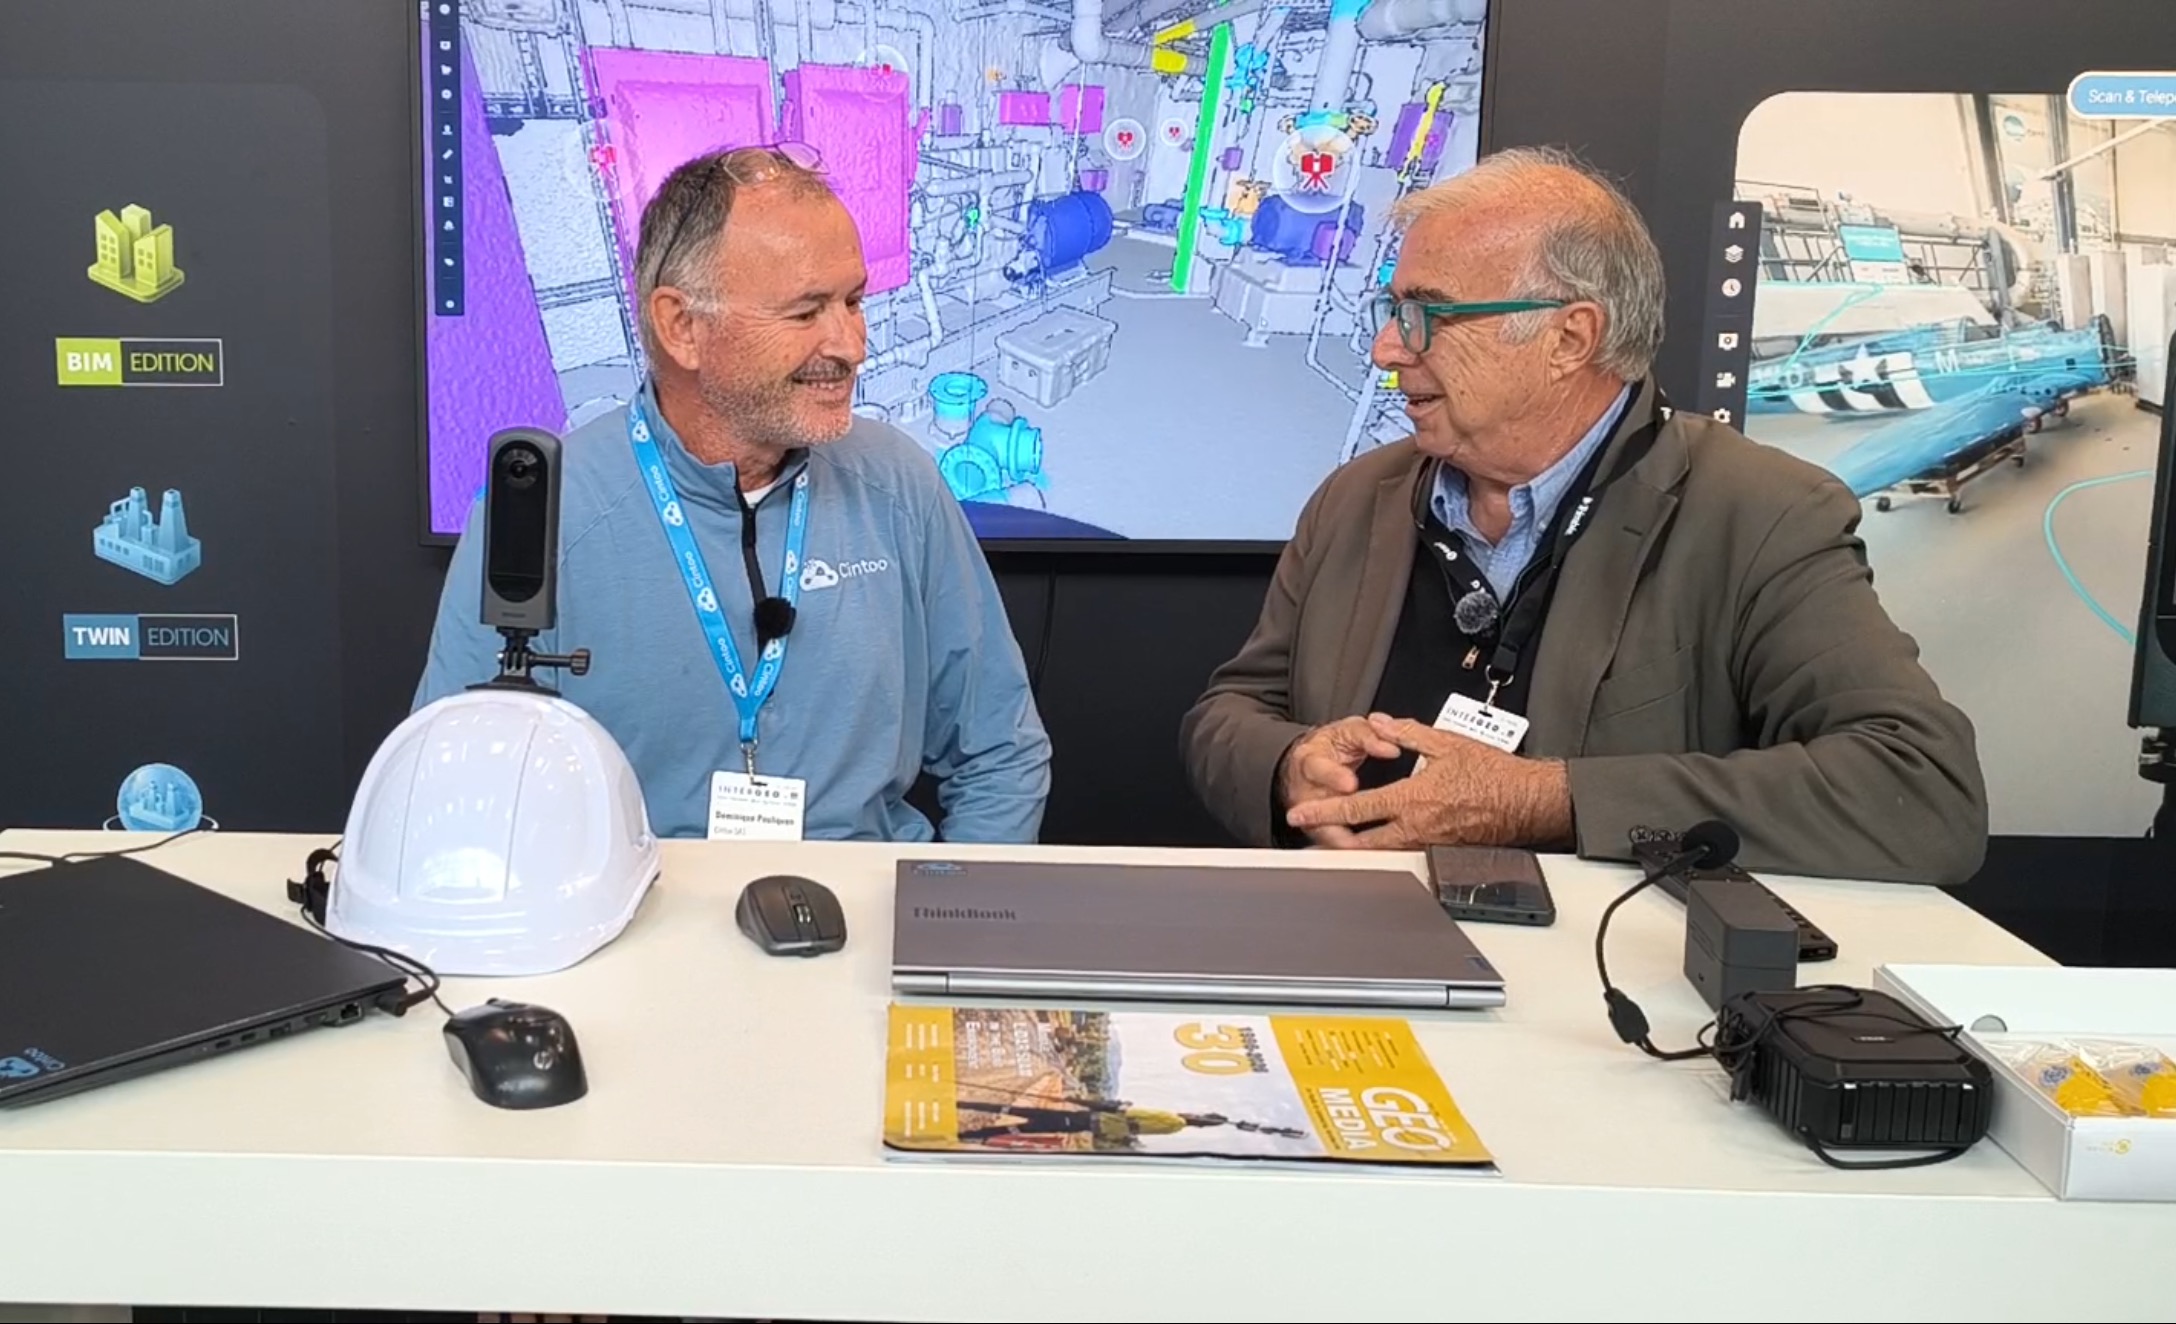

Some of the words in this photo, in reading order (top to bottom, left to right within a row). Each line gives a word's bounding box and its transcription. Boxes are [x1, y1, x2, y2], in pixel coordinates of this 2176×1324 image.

[2088, 89, 2122, 104] Scan
[2125, 89, 2136, 104] &
[2138, 89, 2176, 107] Telep
[67, 352, 113, 372] BIM
[130, 353, 214, 372] EDITION
[650, 465, 669, 501] Cintoo
[685, 551, 704, 588] Cintoo
[839, 559, 888, 578] Cintoo
[72, 627, 130, 646] TWIN
[148, 628, 230, 646] EDITION
[718, 637, 736, 673] Cintoo
[1173, 1022, 1252, 1075] 30
[1318, 1087, 1377, 1149] MEDIA
[1360, 1086, 1451, 1151] GEO
